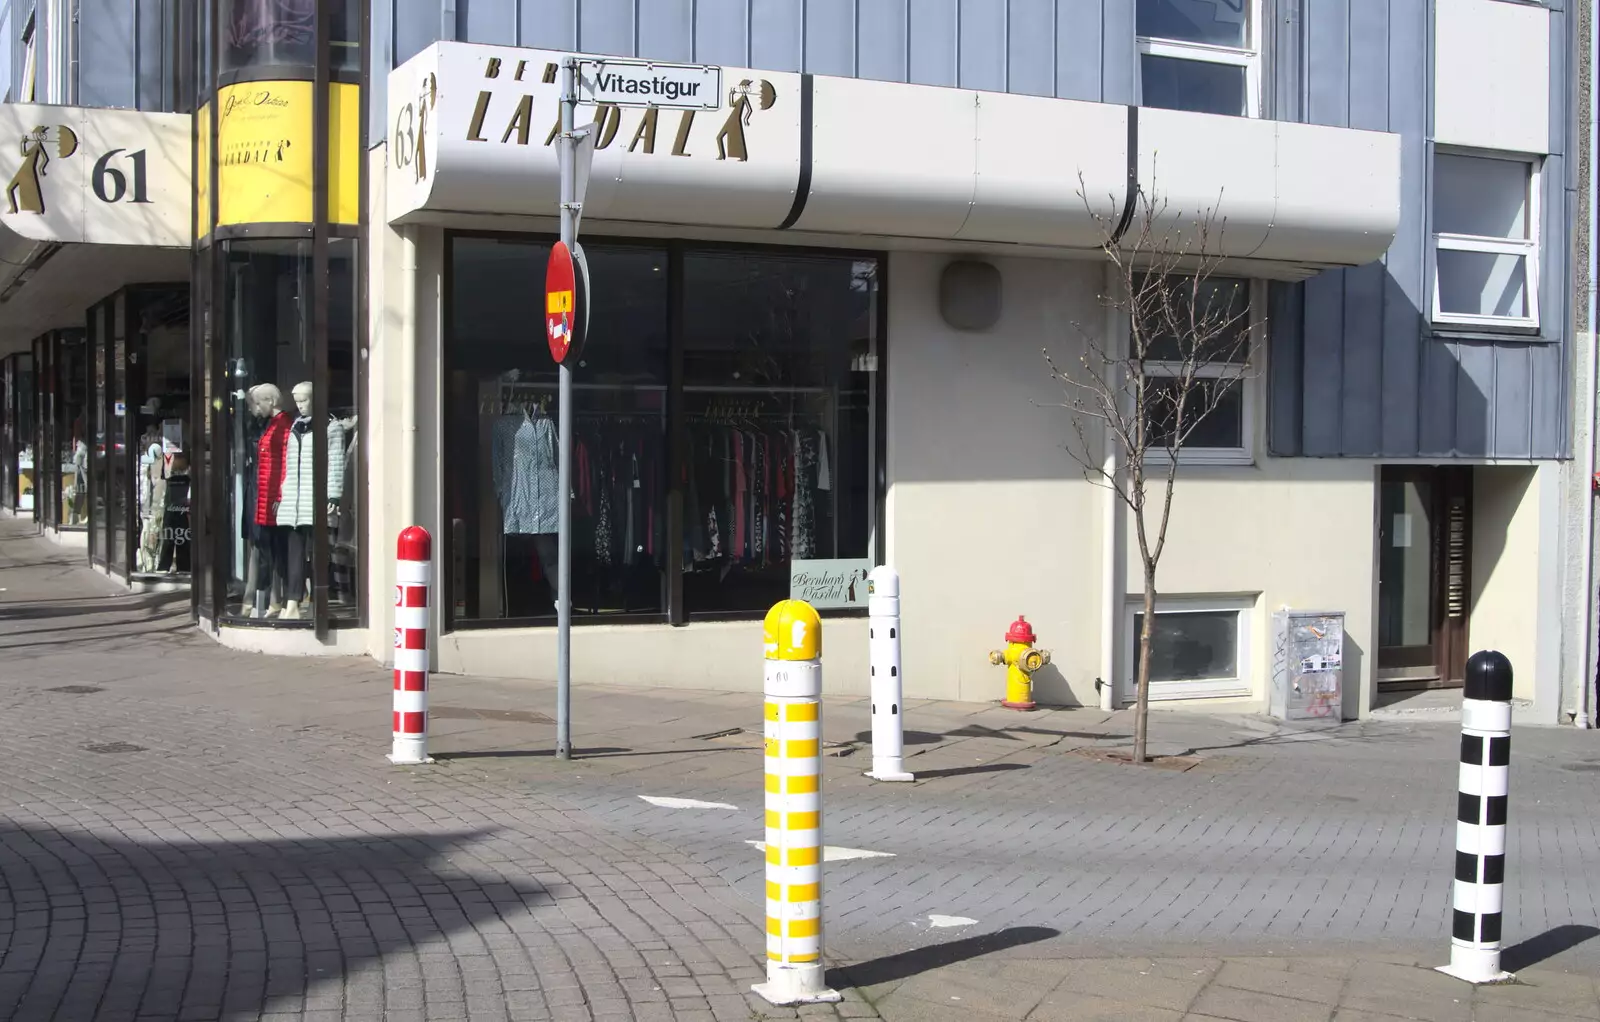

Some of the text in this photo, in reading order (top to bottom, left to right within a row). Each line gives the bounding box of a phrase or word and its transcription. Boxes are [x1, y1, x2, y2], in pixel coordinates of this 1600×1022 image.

[596, 73, 701, 100] Vitastígur
[395, 102, 414, 170] 63
[92, 148, 154, 204] 61
